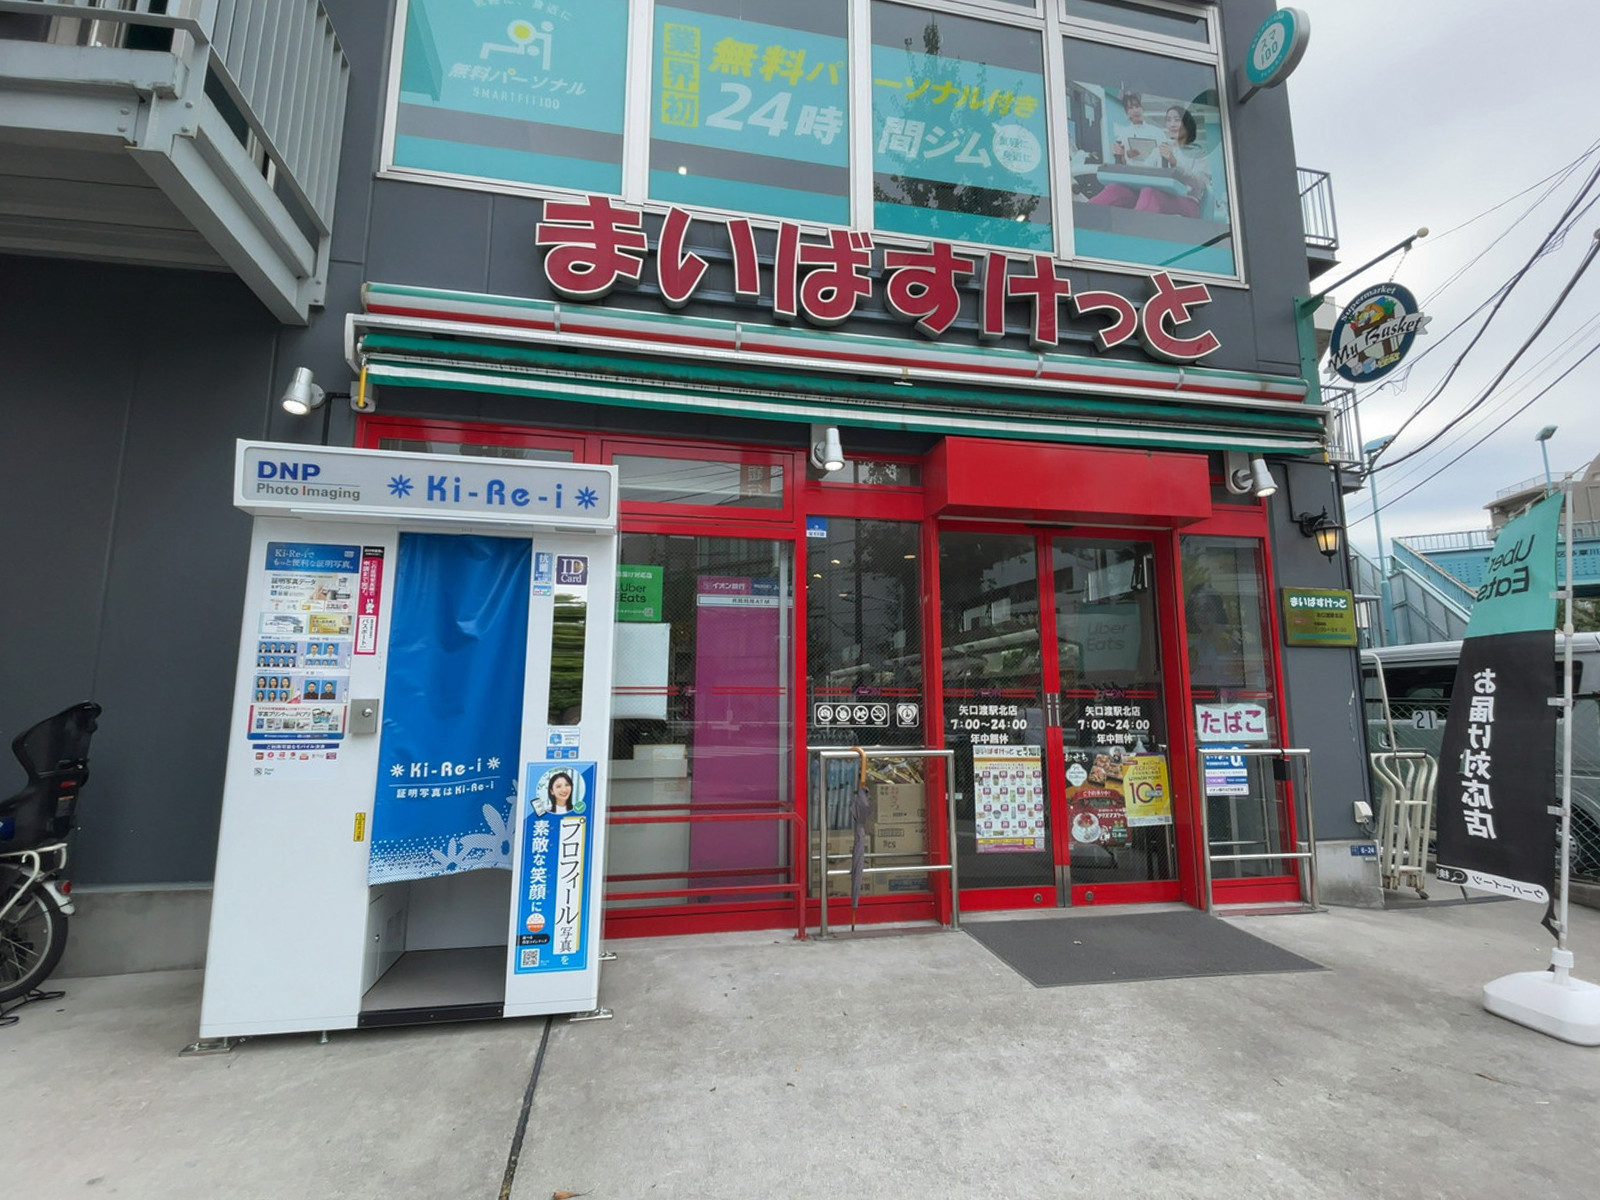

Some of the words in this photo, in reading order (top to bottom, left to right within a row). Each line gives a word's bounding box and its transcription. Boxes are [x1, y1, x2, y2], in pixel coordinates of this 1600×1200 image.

[448, 62, 586, 95] 無料パーソナル
[662, 22, 700, 128] 業界初
[535, 195, 1222, 361] まいばすけっと
[1328, 343, 1359, 370] My
[1365, 316, 1422, 345] Basket
[257, 461, 321, 481] DNP
[256, 482, 299, 497] Photo
[302, 486, 361, 501] Imaging
[427, 475, 563, 509] Ki-Re-i
[561, 558, 584, 575] ID
[561, 574, 582, 583] Card
[620, 583, 646, 593] Uber
[620, 593, 647, 603] Eats
[1290, 596, 1347, 609] まいばすけっと
[958, 705, 1018, 716] 矢口渡駅北店
[1084, 706, 1141, 717] 矢口渡駅北店
[1200, 710, 1264, 734] たばこ
[1416, 712, 1434, 729] 21
[970, 733, 1009, 744] 年中無休
[1096, 734, 1133, 744] 年中無休
[410, 757, 482, 779] Ki-Re-i
[528, 820, 549, 912] 素敵な笑顔に
